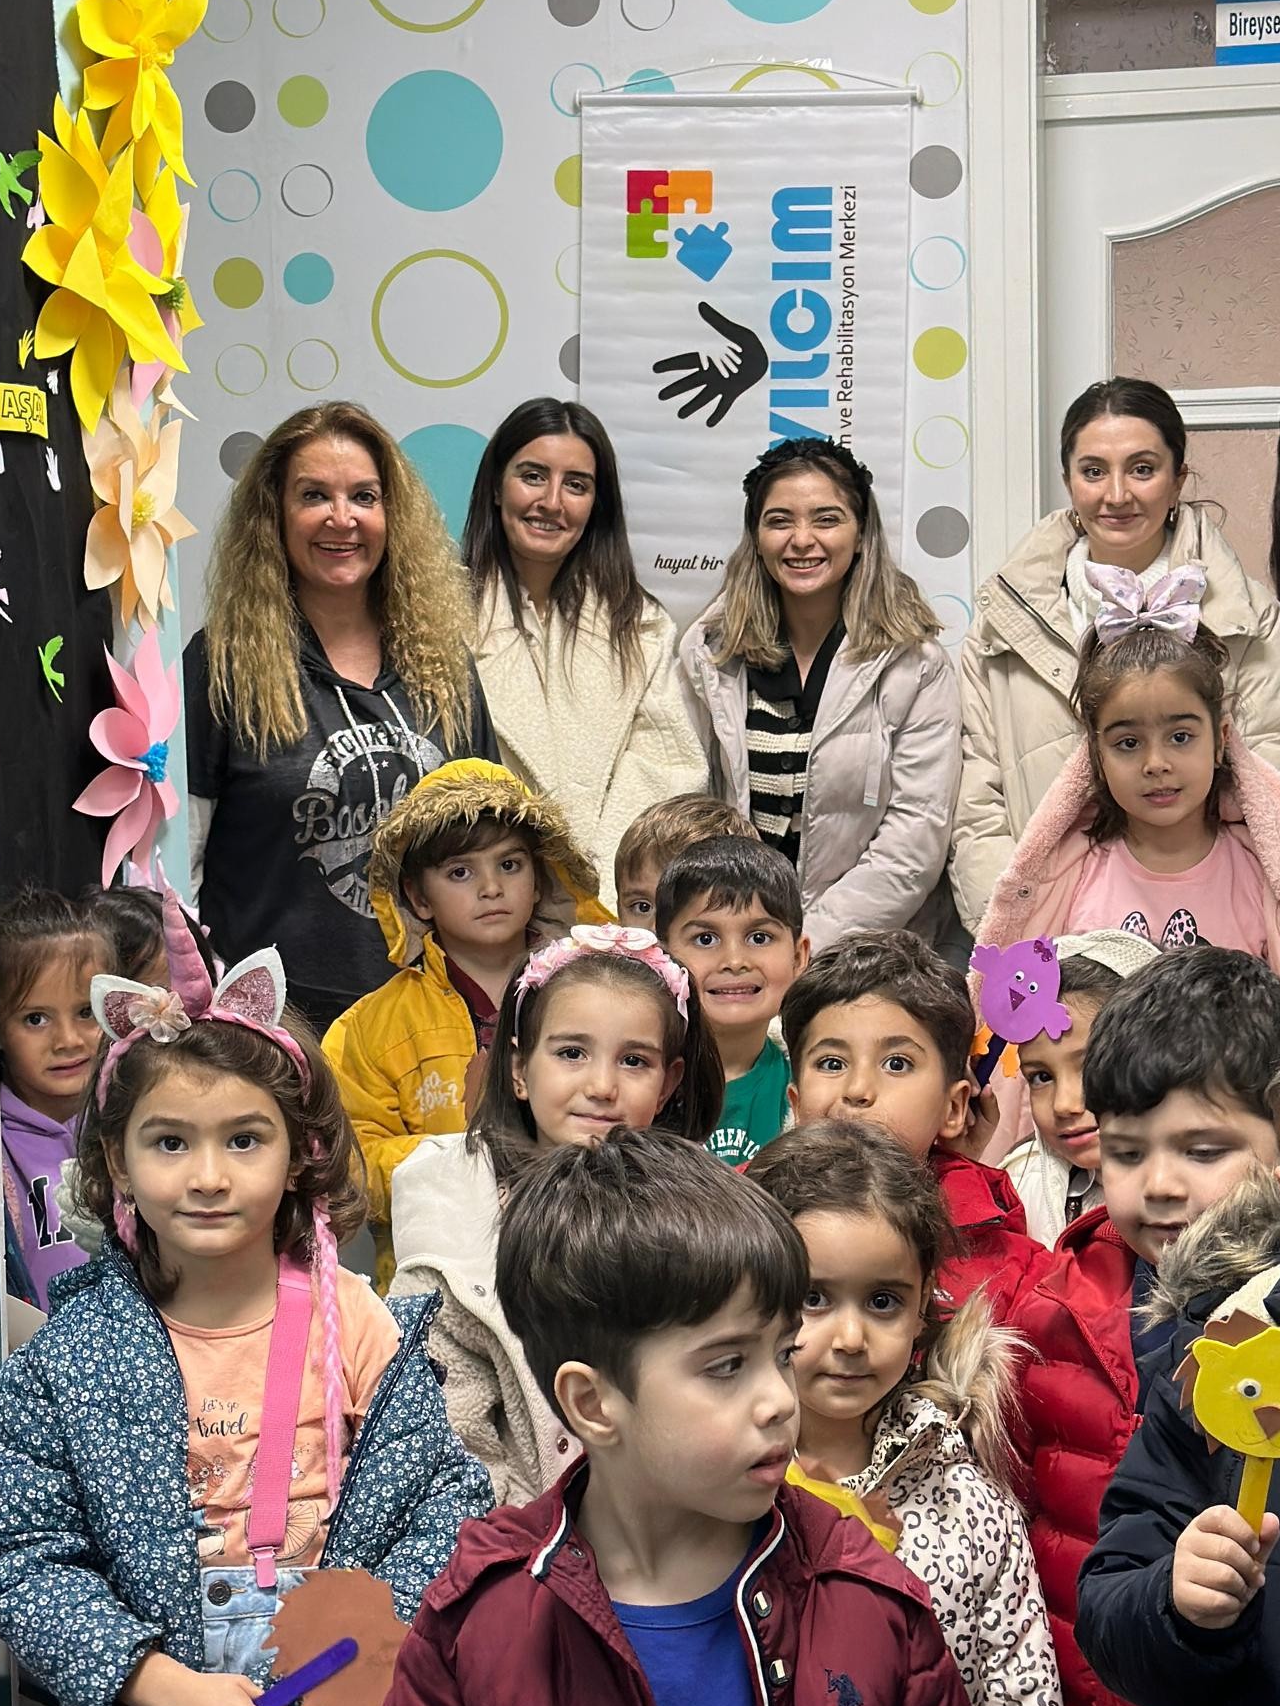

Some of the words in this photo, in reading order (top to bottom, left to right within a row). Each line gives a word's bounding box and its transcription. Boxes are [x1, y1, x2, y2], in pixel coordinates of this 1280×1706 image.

[838, 184, 857, 260] Merkezi
[836, 266, 859, 402] Rehabilitasyon
[839, 408, 853, 430] ve
[654, 553, 699, 575] hayat
[226, 1399, 240, 1414] go
[191, 1411, 249, 1439] travel
